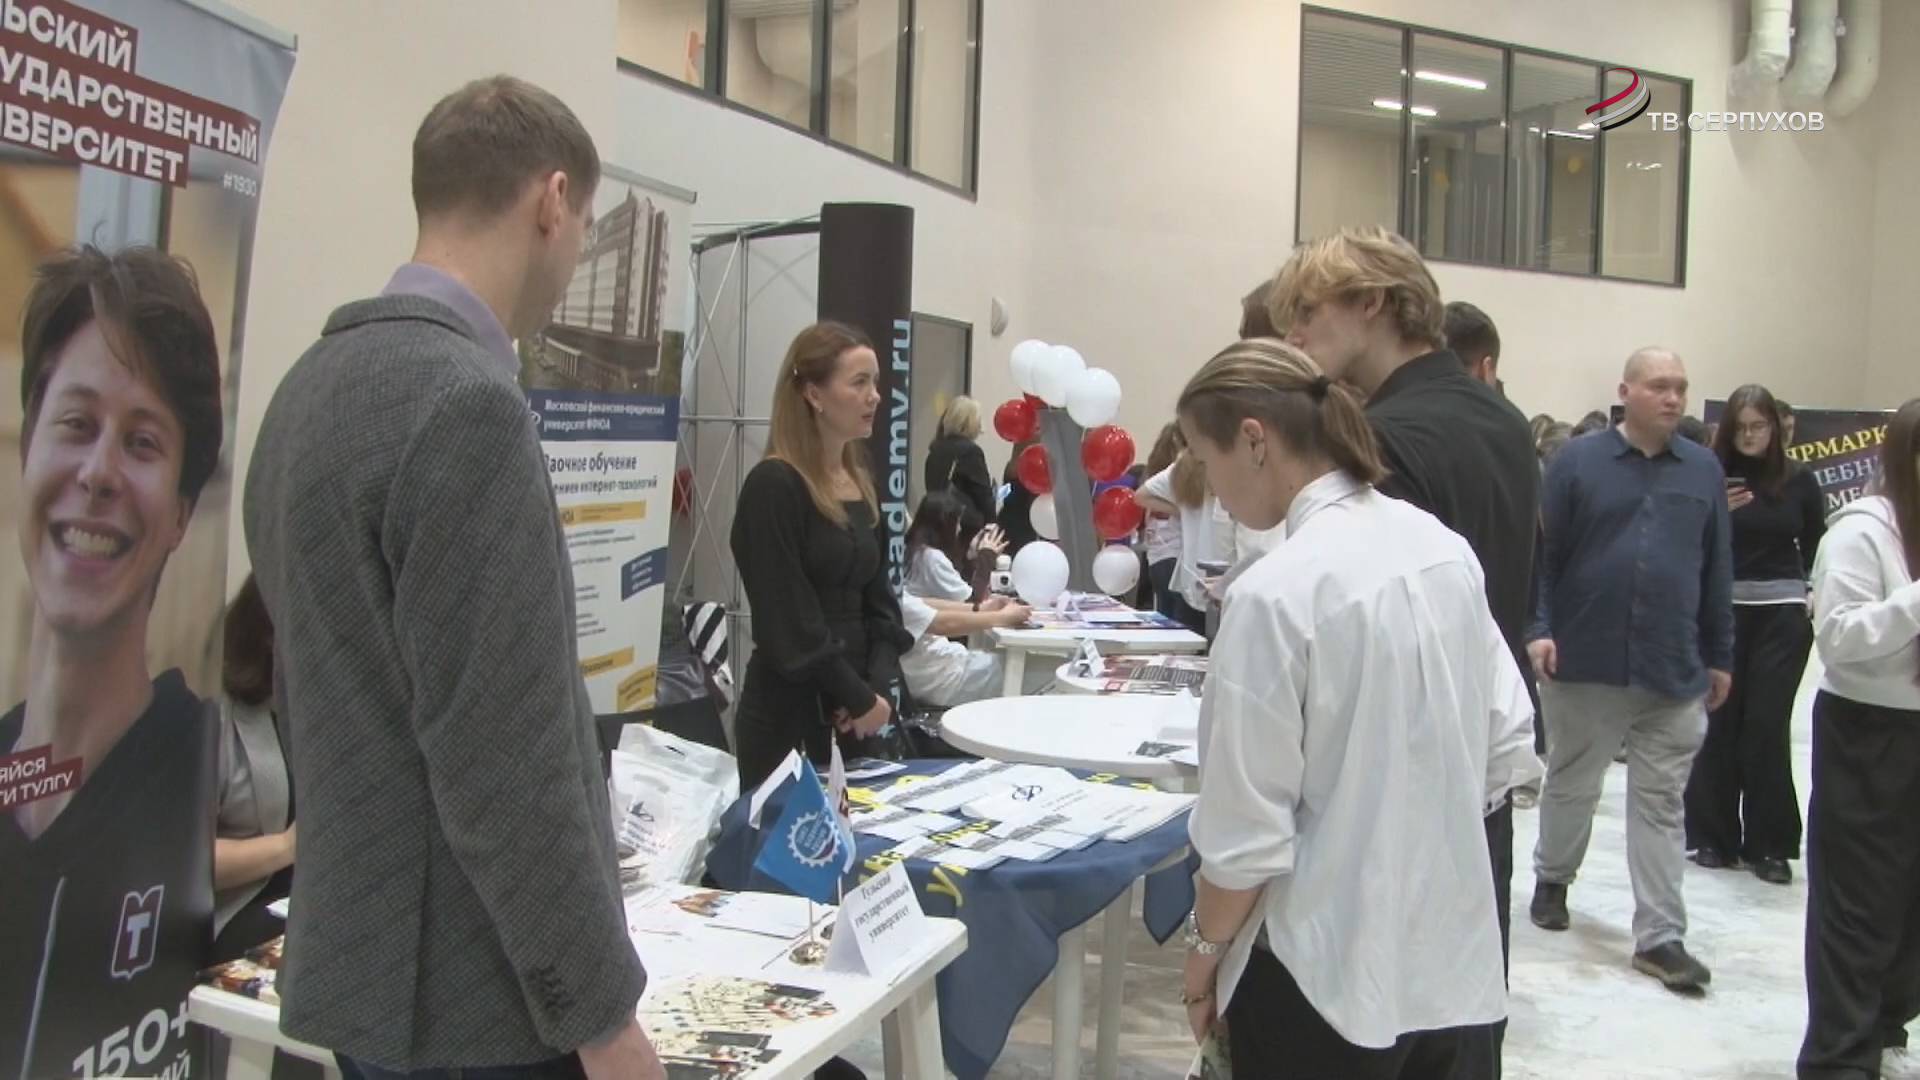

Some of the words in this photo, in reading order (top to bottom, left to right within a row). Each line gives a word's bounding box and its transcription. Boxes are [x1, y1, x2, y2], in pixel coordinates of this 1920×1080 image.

[0, 0, 132, 72] ЬСКИЙ
[0, 103, 184, 182] ВЕРСИТЕТ
[223, 171, 257, 197] #1930
[544, 399, 587, 413] Московский
[543, 418, 586, 432] университет
[588, 451, 637, 475] обучение
[20, 770, 73, 800] ТУЛГУ
[860, 871, 892, 901] Тульский
[854, 880, 910, 929] государственный
[868, 904, 910, 944] университет
[72, 1001, 188, 1078] 150+
